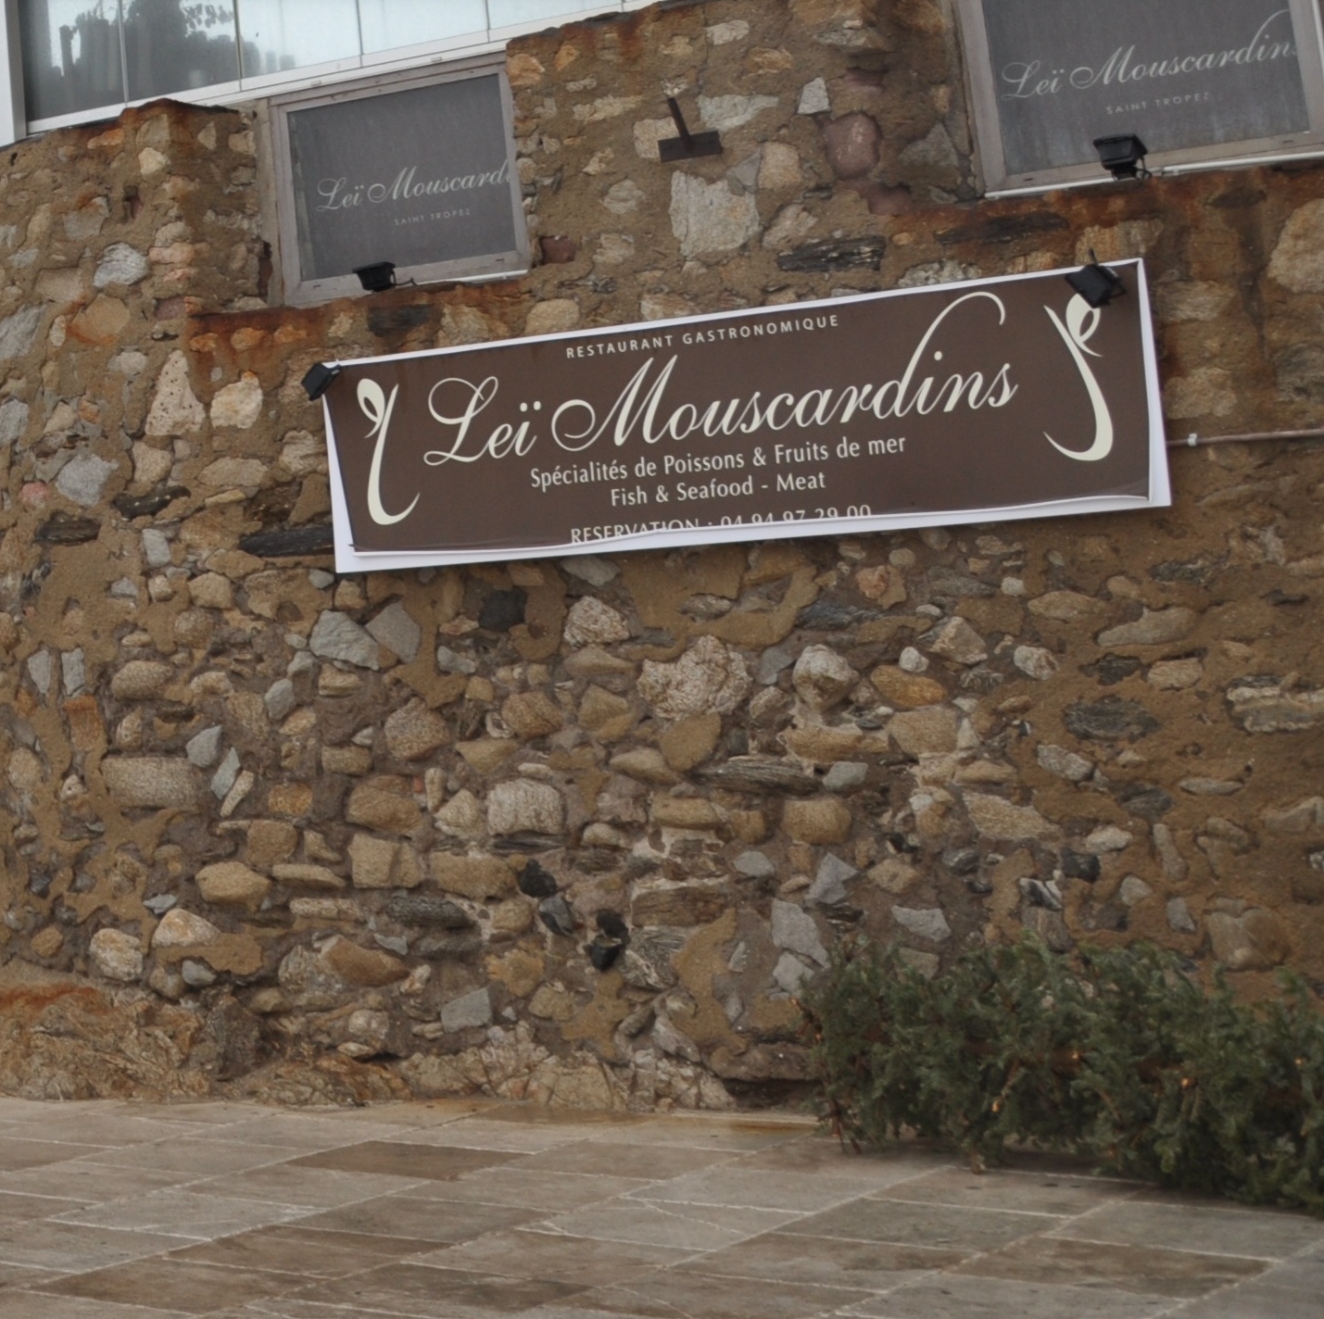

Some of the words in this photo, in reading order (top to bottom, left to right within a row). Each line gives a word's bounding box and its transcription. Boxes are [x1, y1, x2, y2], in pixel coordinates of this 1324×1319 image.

[1069, 9, 1297, 90] Mouscardin
[1106, 100, 1148, 115] SAINT
[1155, 92, 1211, 108] TROPEZ
[394, 214, 425, 226] SAINT
[430, 207, 471, 220] TROPEZ
[566, 335, 674, 359] RESTAURANT
[682, 315, 840, 345] GASTRONOMIQUE
[423, 376, 542, 466] Leï
[551, 291, 1018, 452] Mouscardins
[530, 458, 628, 492] Spécialités
[634, 457, 657, 478] de
[664, 451, 745, 475] Poissons
[752, 446, 767, 467] &
[774, 440, 829, 464] Fruits
[836, 436, 861, 459] de
[867, 436, 907, 456] mer
[610, 485, 648, 507] Fish
[655, 484, 669, 503] &
[676, 475, 754, 501] Seafood
[776, 471, 827, 493] Meat
